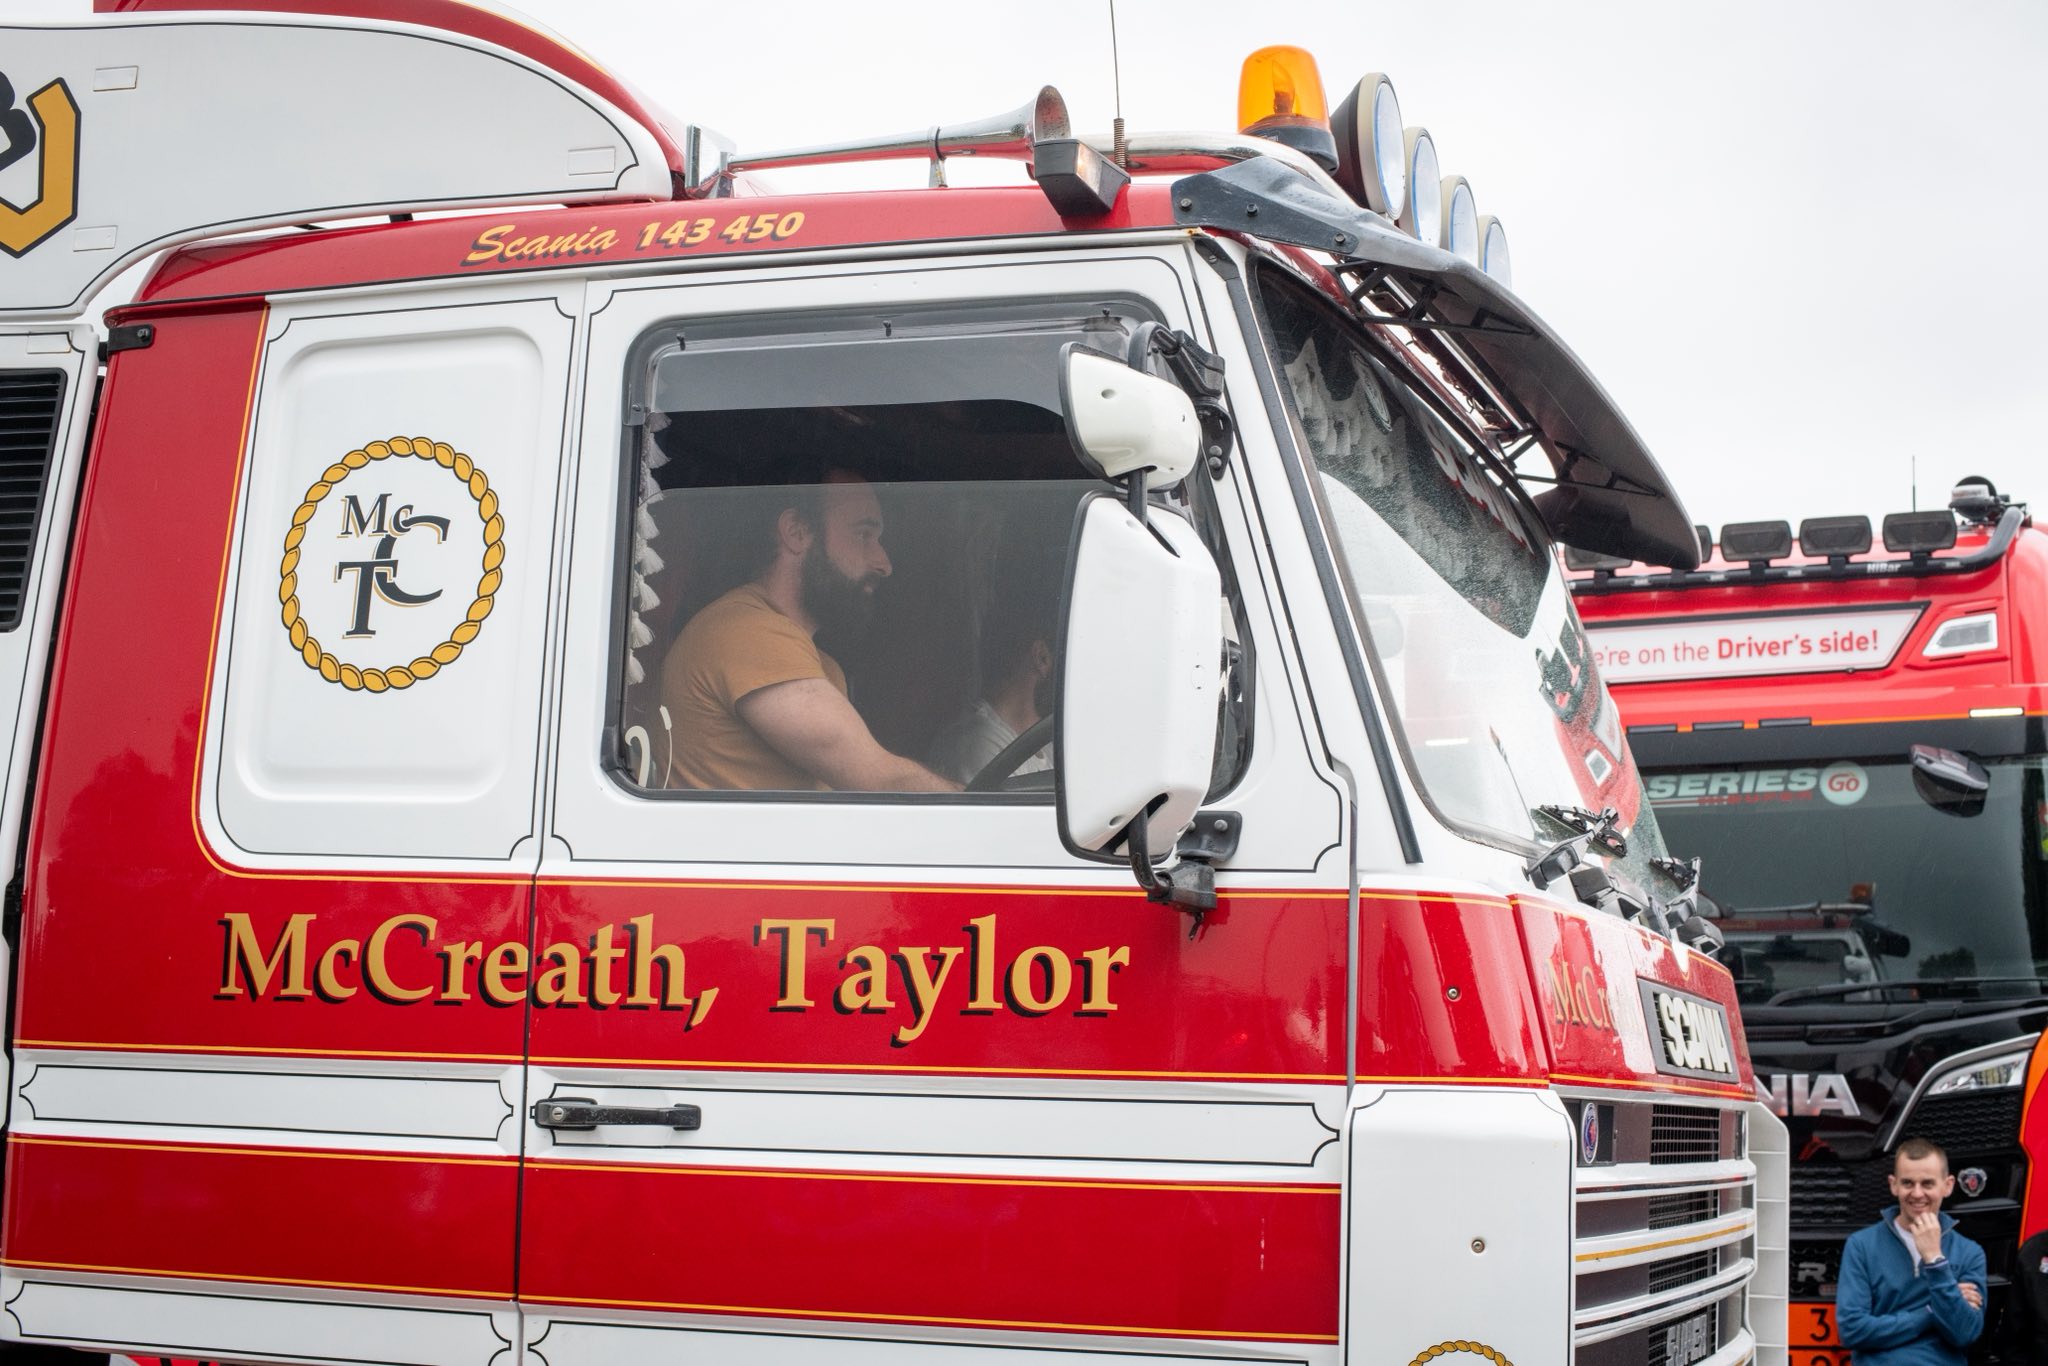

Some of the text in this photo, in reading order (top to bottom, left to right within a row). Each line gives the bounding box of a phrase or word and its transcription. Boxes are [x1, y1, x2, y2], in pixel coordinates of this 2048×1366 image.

[460, 211, 805, 267] Scania 143 450
[1596, 629, 1879, 667] e're on the Driver's side!
[1649, 767, 1819, 798] SERIES
[213, 912, 1130, 1048] McCreath, Taylor
[1752, 1073, 1861, 1117] NIA
[1810, 1307, 1831, 1343] 3
